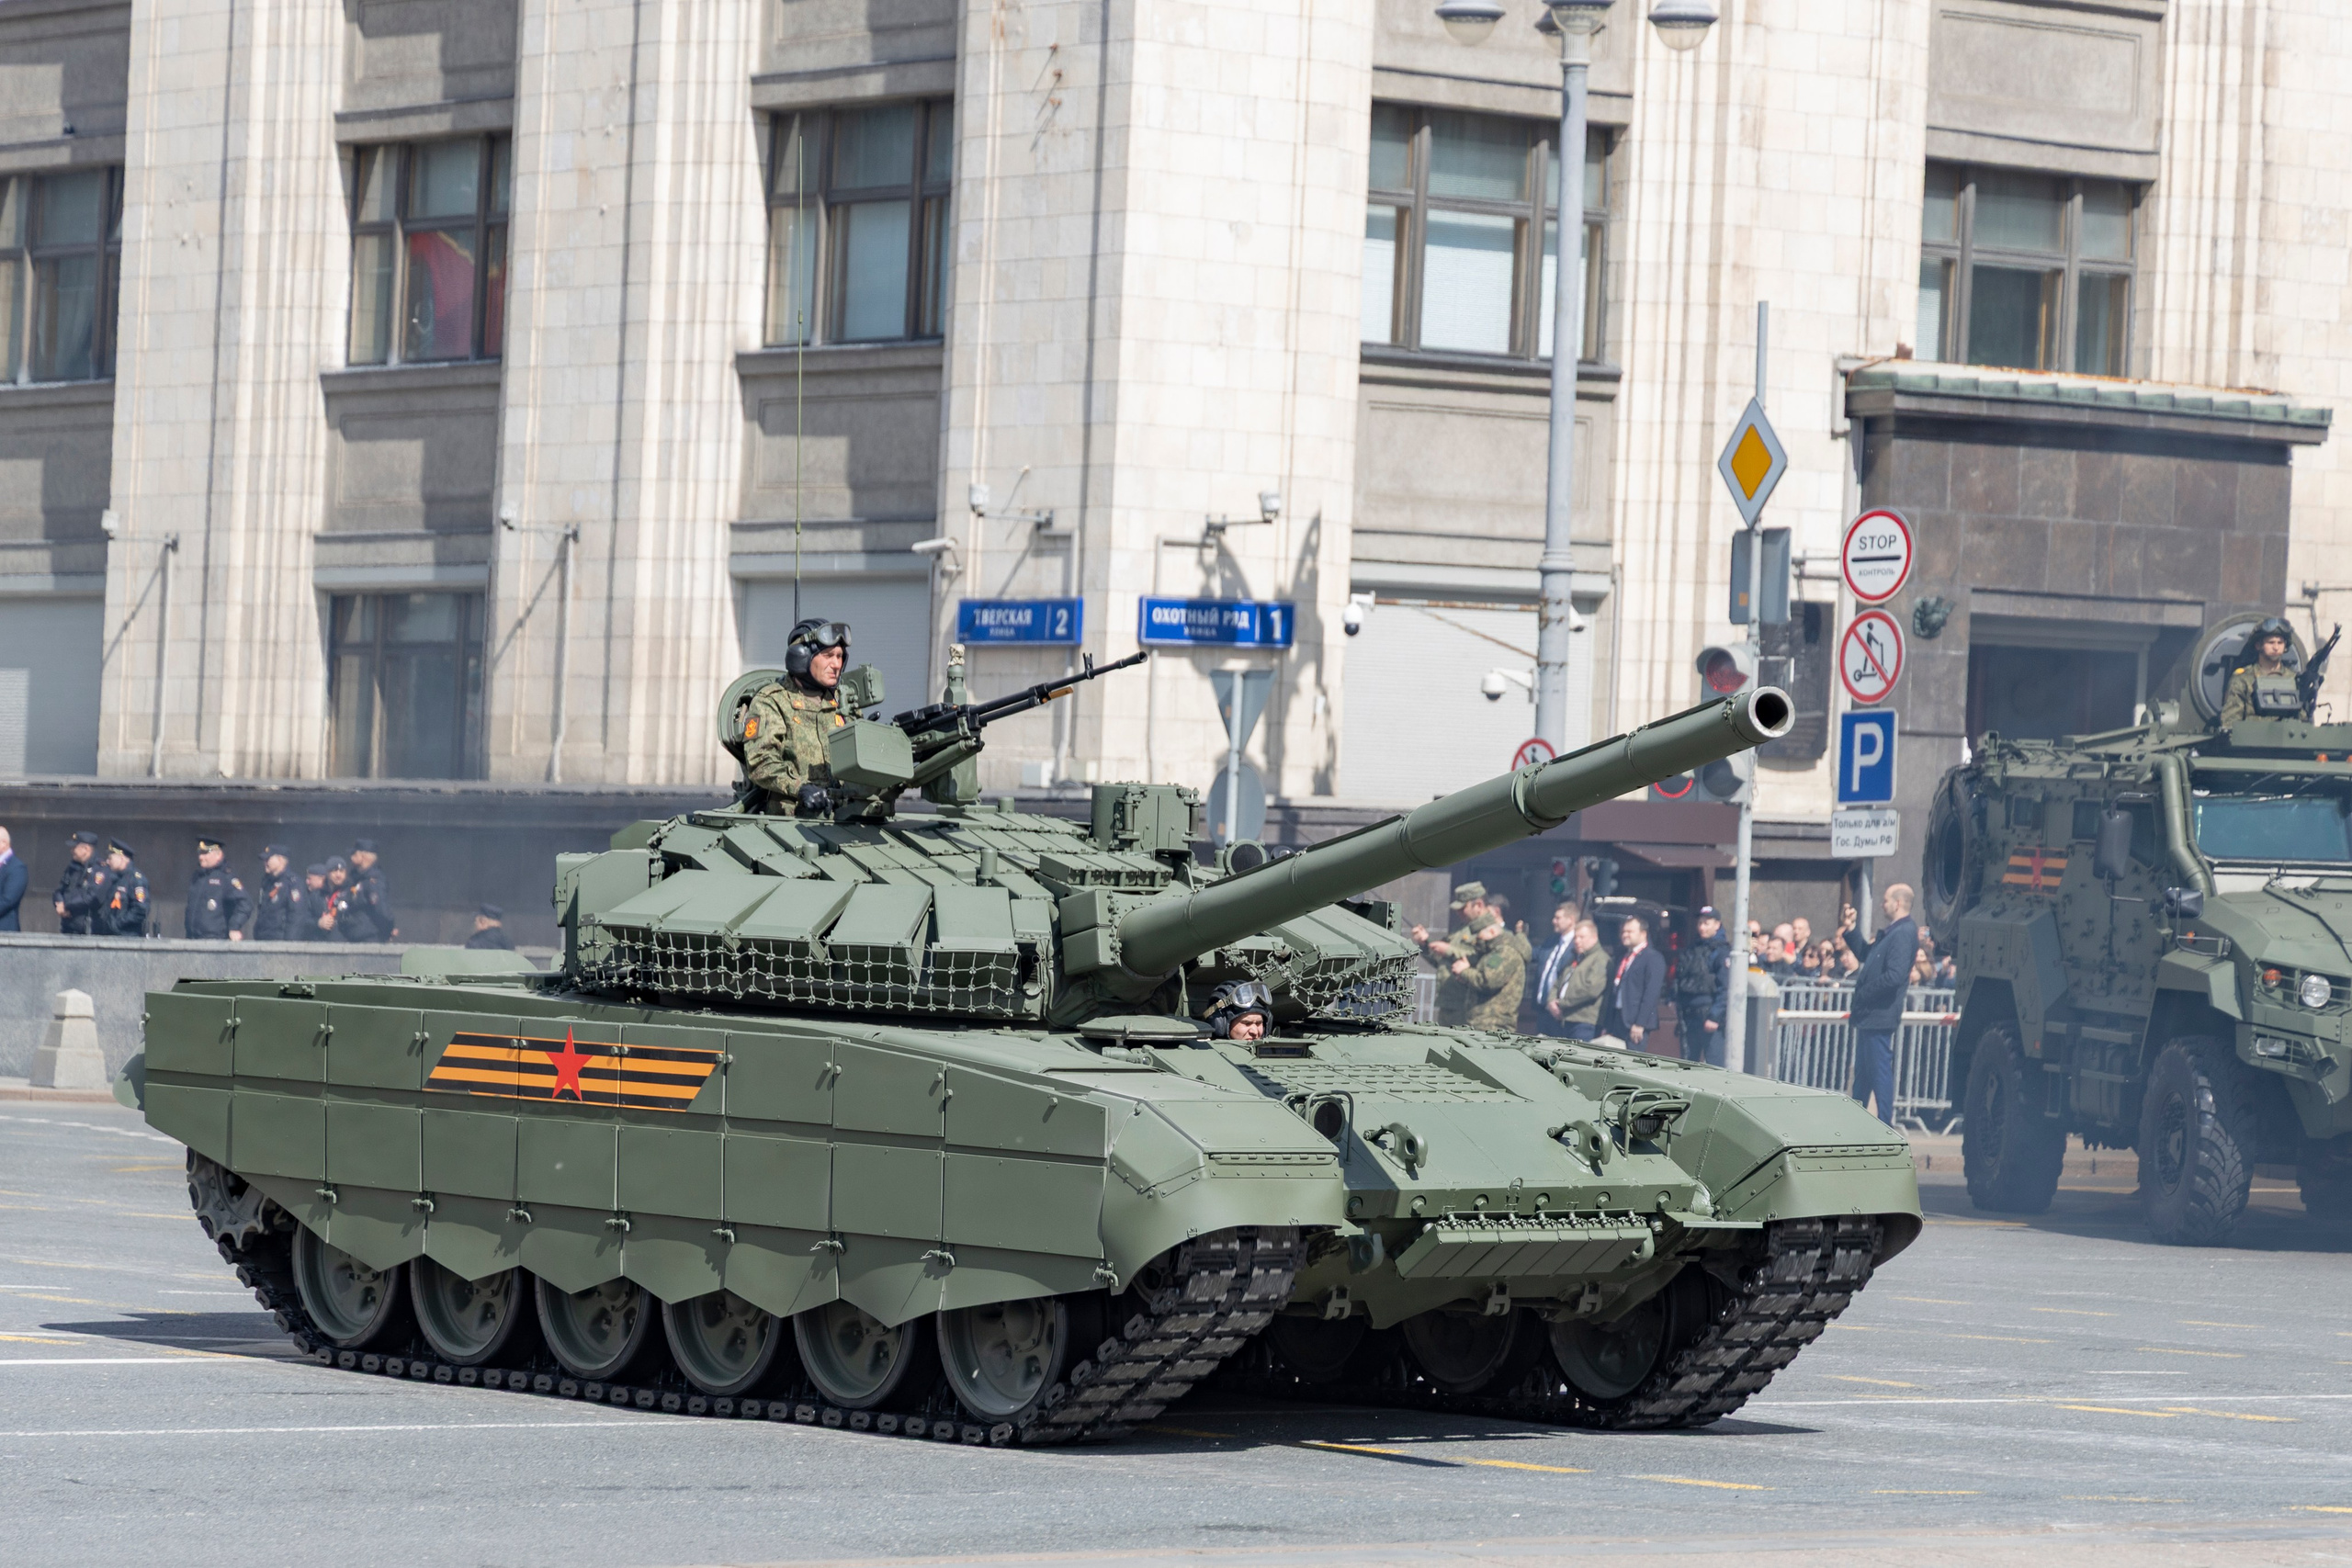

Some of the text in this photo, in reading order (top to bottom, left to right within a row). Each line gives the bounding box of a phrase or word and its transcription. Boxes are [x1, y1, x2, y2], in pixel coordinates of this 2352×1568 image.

[1859, 535, 1897, 550] STOP
[1859, 568, 1895, 577] КОНТРОЛЬ
[973, 608, 1033, 626] ТВЕРСКАЯ
[1055, 607, 1069, 637] 2
[1151, 606, 1250, 629] ОХОТНЫЙ РЯД
[1270, 608, 1283, 639] 1
[1851, 722, 1884, 793] P
[1834, 816, 1896, 829] Только для а/м
[1836, 834, 1893, 849] Гос. Думы РФ
